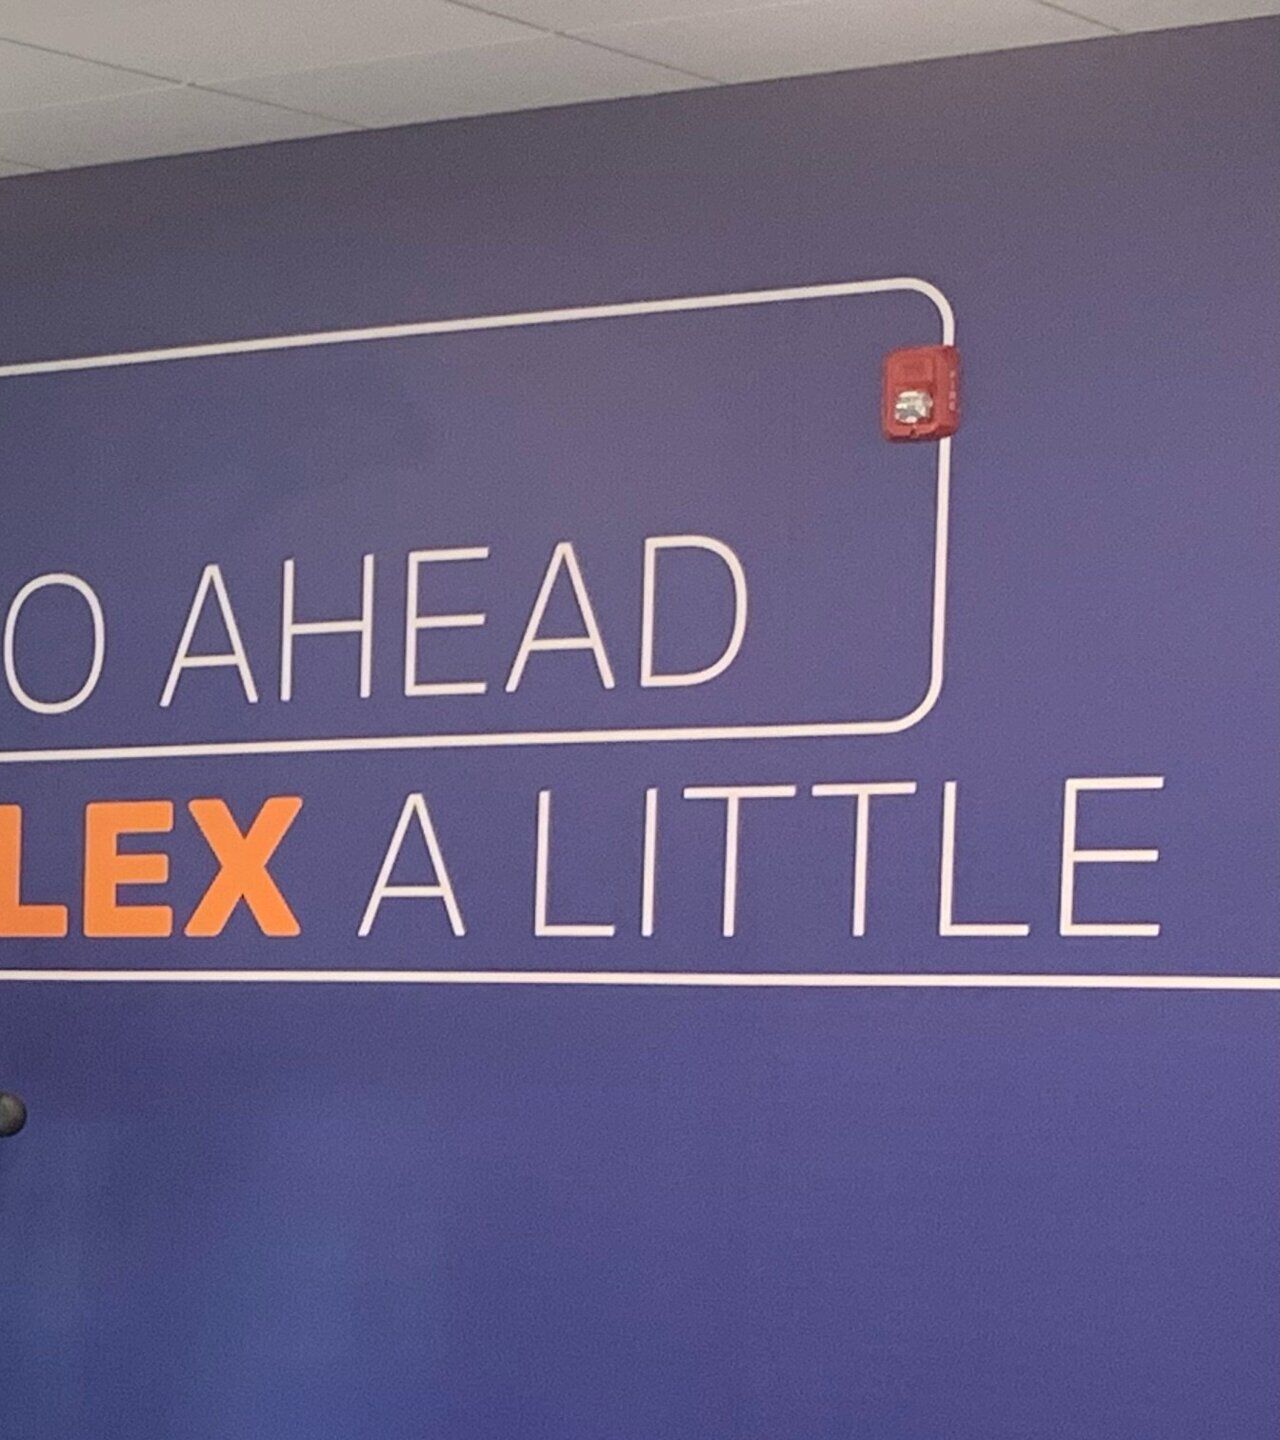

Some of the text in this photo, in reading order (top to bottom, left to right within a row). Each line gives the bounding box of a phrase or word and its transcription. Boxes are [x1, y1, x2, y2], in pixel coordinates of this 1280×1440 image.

[158, 534, 750, 708] AHEAD
[356, 792, 466, 939] A
[534, 775, 1165, 939] LITTLE
